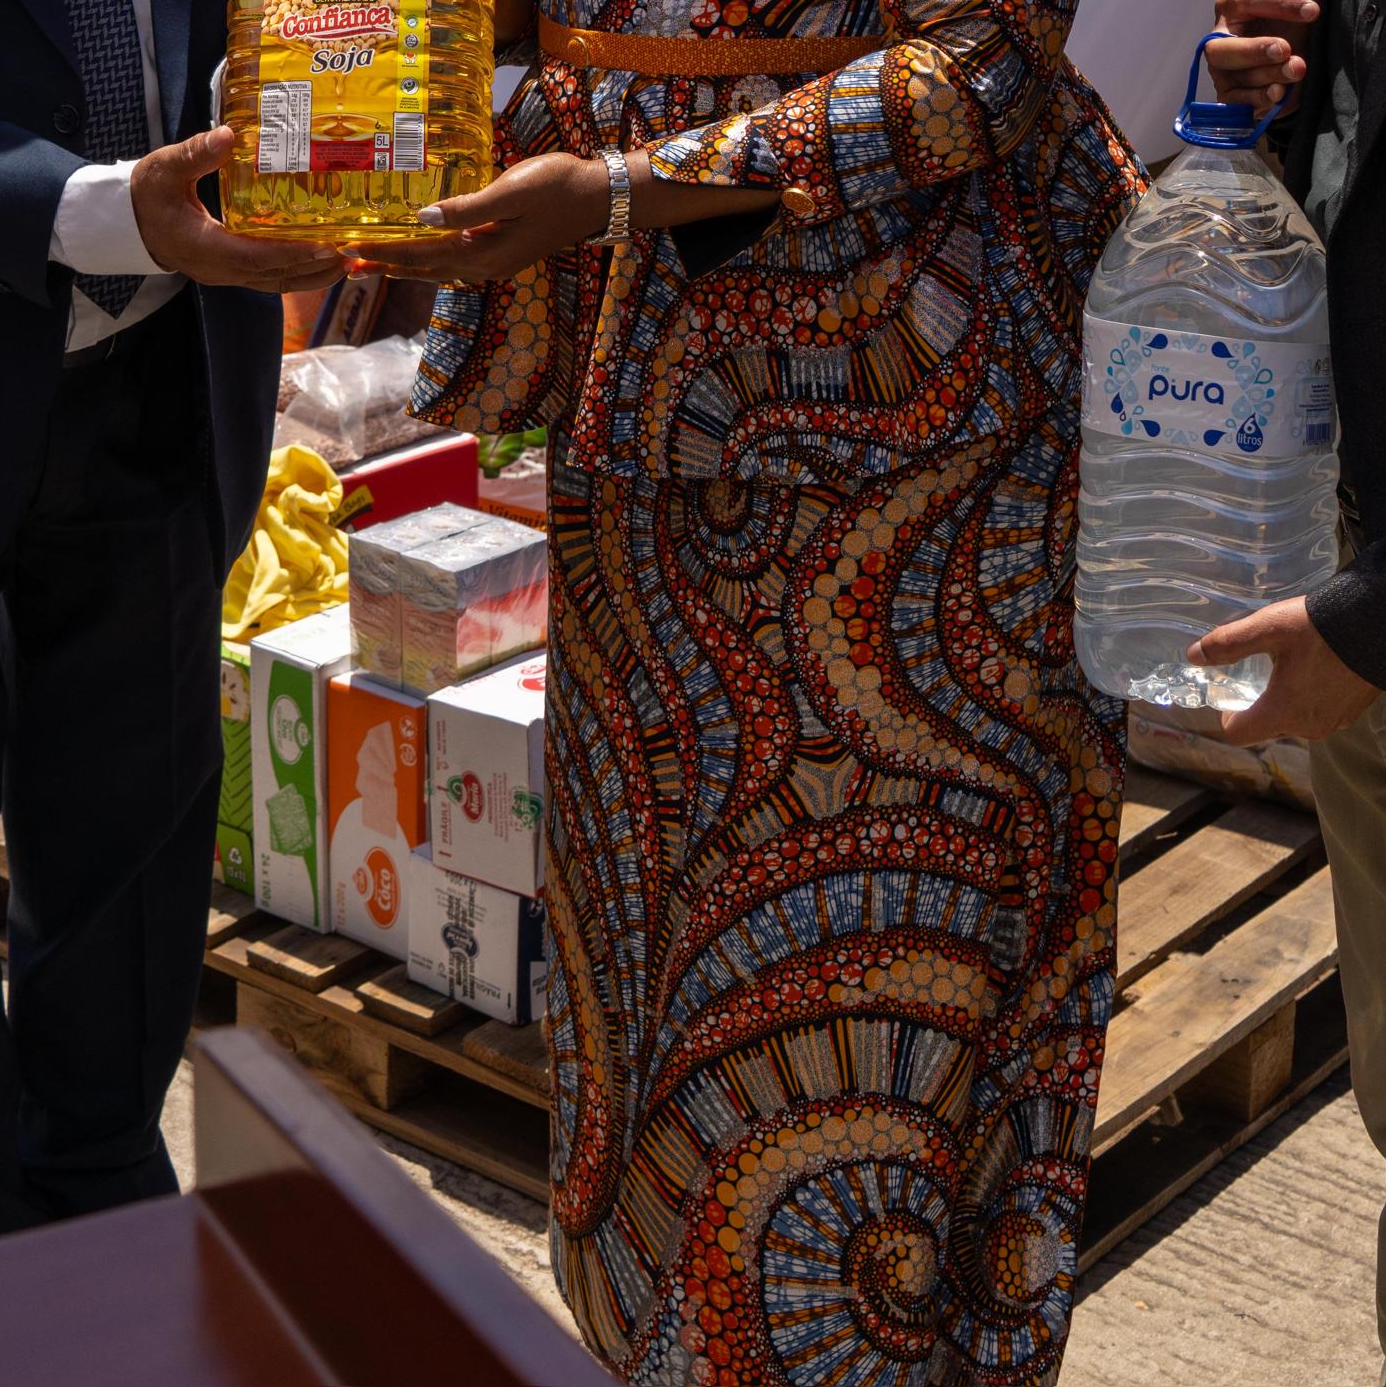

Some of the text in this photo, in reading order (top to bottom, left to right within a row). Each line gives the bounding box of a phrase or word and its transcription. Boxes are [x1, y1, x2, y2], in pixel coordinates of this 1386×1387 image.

[311, 46, 373, 74] Soja
[376, 135, 389, 147] 5L
[1148, 374, 1225, 406] pura
[1243, 416, 1256, 434] 6
[1237, 431, 1262, 446] litros
